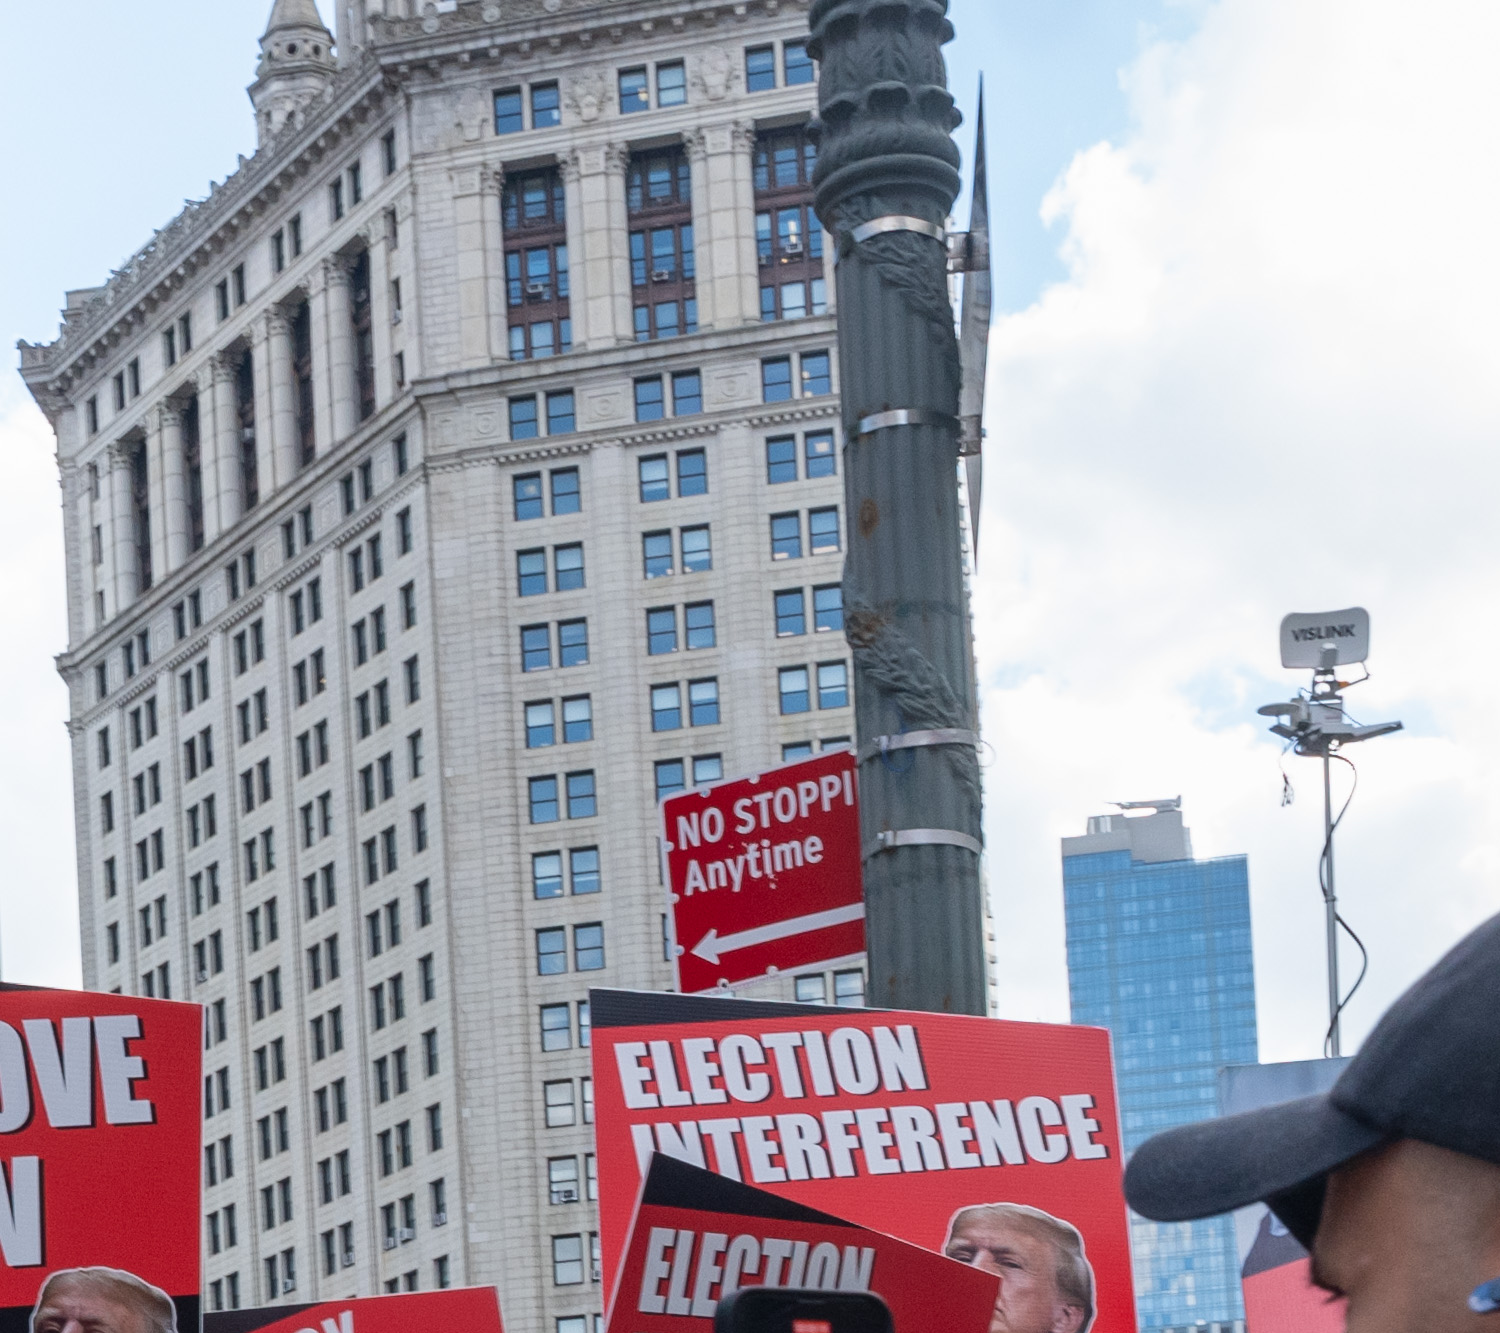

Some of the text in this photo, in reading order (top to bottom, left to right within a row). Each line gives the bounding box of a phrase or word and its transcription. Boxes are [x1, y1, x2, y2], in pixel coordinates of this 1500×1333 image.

[1290, 624, 1356, 643] VISLINK
[676, 769, 855, 851] NO STOPPI
[683, 834, 825, 897] Anytime
[613, 1024, 928, 1109] ELECTION
